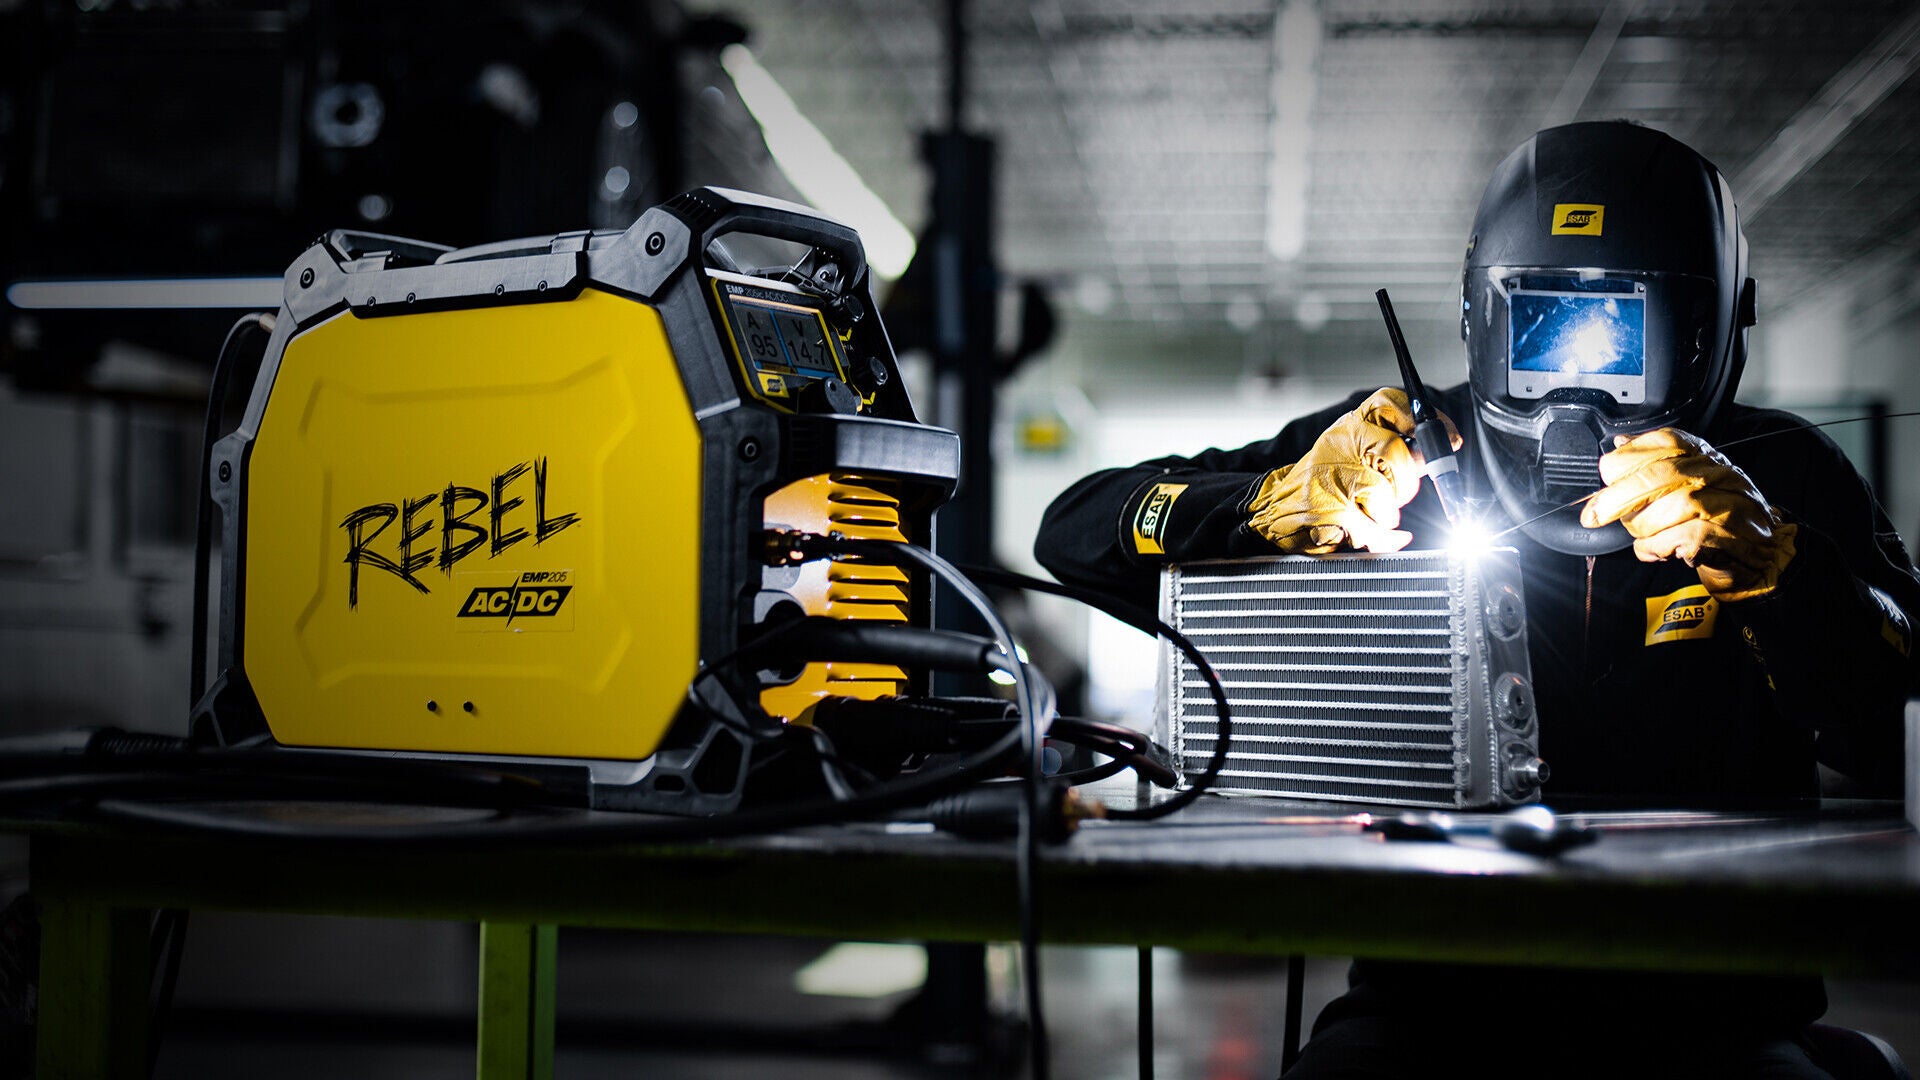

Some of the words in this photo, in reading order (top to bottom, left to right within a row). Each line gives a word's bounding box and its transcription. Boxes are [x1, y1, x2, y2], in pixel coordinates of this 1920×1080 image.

[725, 284, 744, 295] EMP
[748, 312, 761, 330] A
[791, 319, 805, 337] V
[751, 333, 779, 358] 95
[1144, 493, 1168, 539] ESAB
[338, 455, 581, 613] REBEL
[1664, 607, 1705, 622] ESAB
